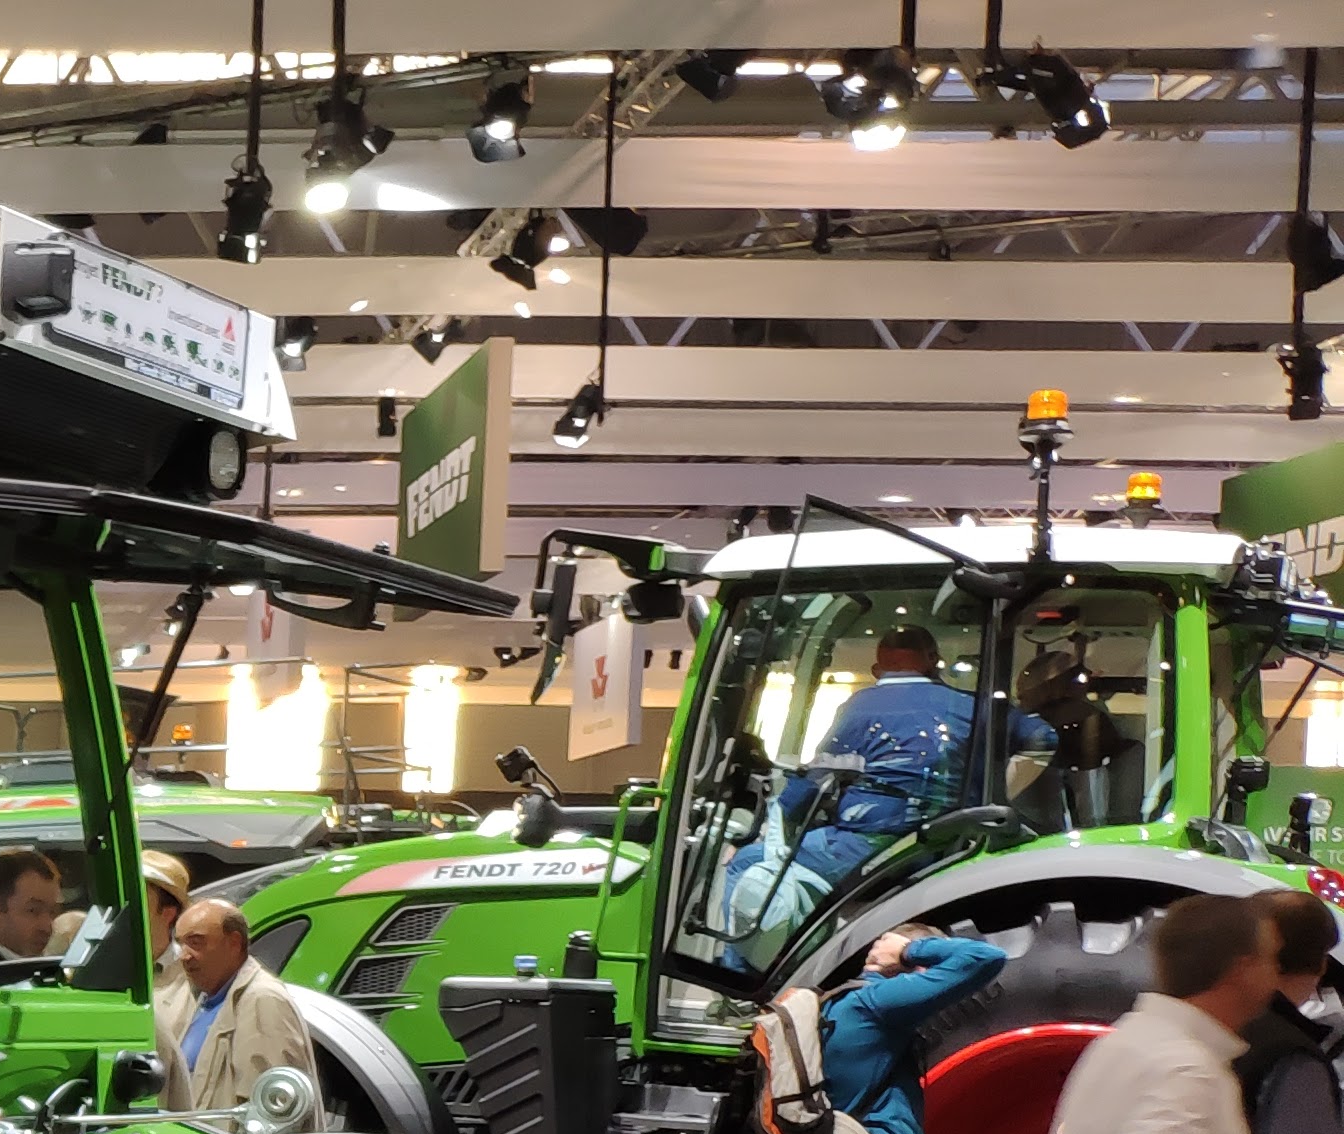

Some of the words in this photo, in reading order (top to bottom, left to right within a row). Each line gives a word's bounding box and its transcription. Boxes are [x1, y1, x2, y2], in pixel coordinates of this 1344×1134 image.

[406, 435, 477, 539] FENDT
[433, 862, 522, 880] FENDT
[532, 861, 577, 877] 720
